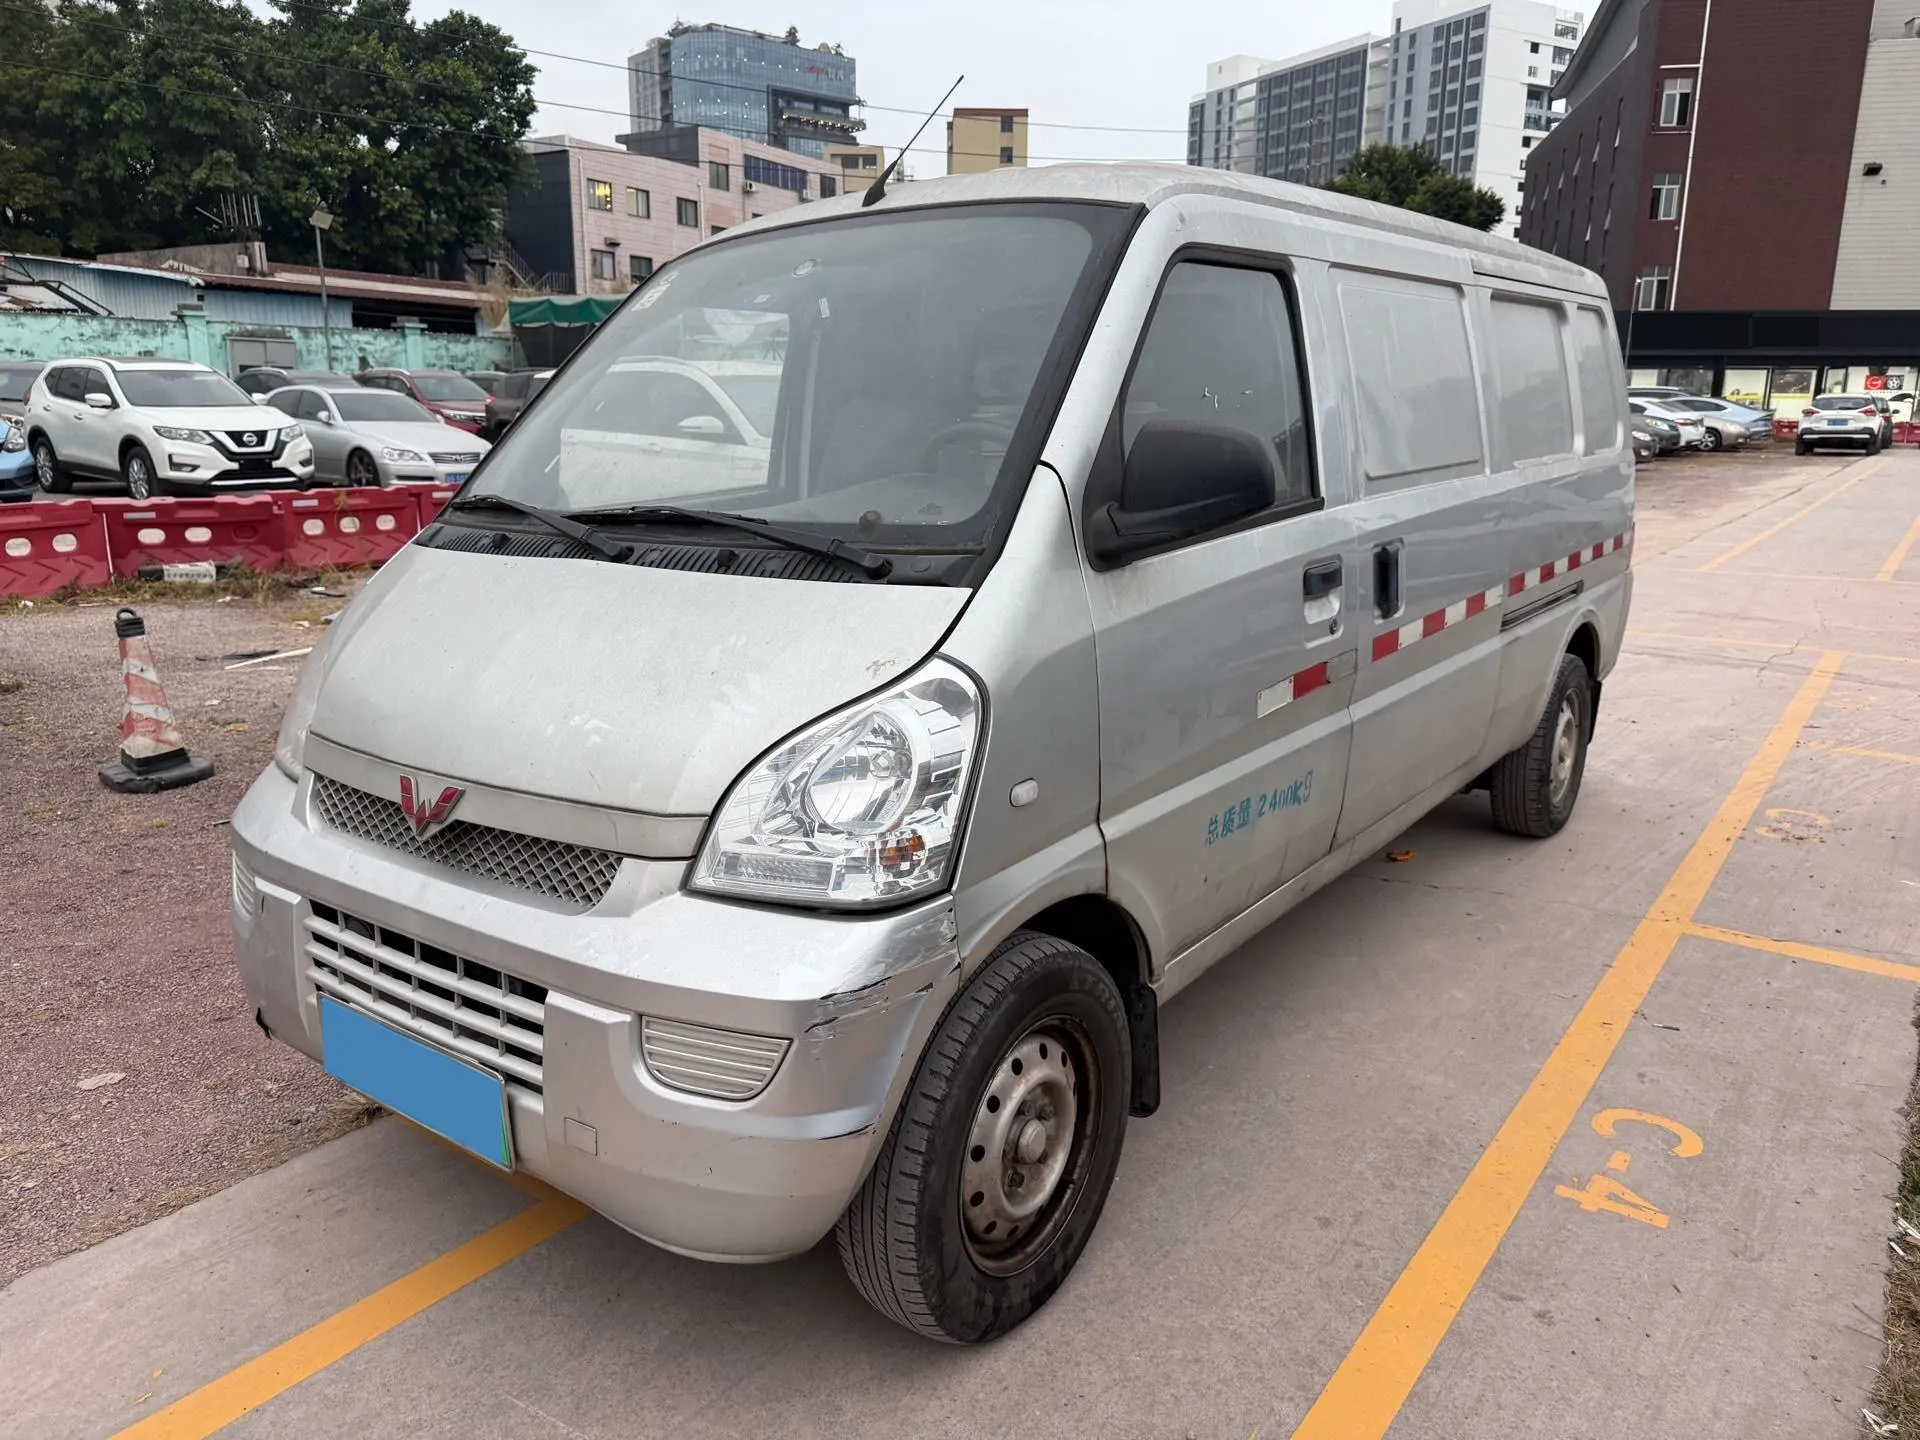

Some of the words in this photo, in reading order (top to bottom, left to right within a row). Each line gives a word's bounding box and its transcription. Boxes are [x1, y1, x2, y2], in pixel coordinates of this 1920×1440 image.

[1205, 797, 1251, 846] 总质量
[1553, 1107, 1704, 1229] C-4
